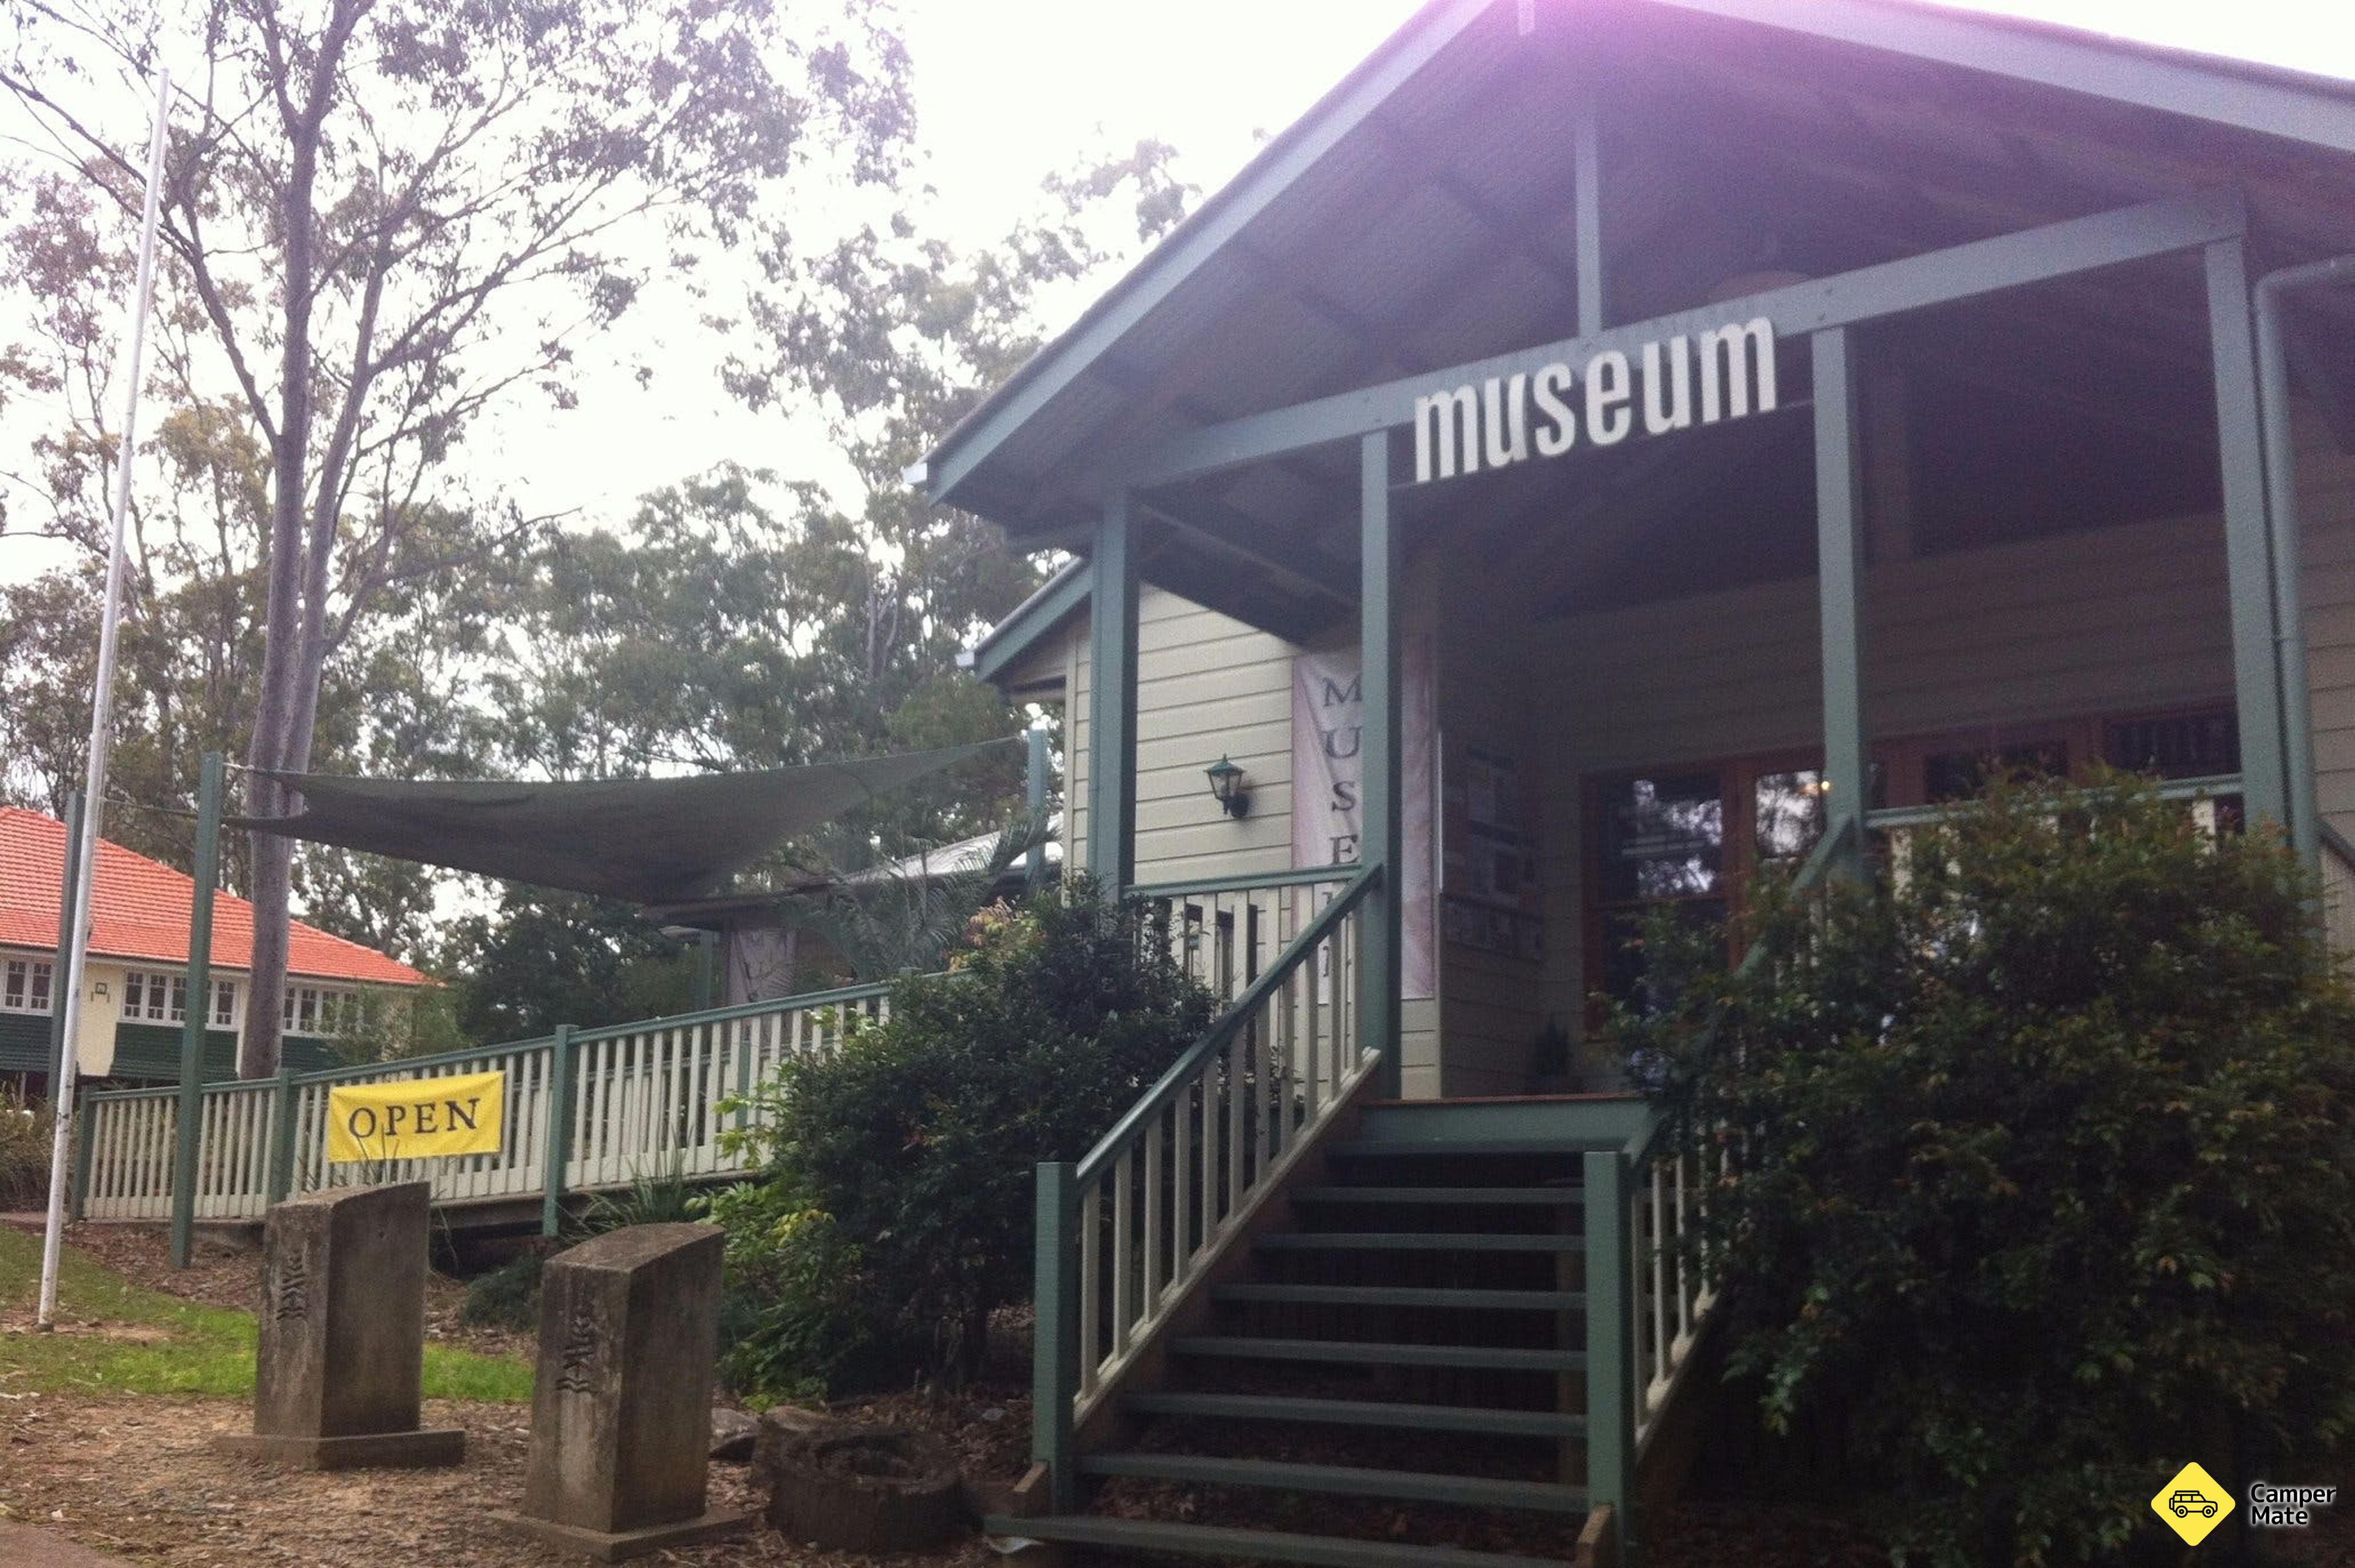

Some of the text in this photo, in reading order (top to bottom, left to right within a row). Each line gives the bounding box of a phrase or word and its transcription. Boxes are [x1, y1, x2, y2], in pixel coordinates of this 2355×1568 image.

[1414, 317, 1776, 483] museum
[1322, 675, 1362, 978] MUSE
[349, 1098, 480, 1138] OPEN
